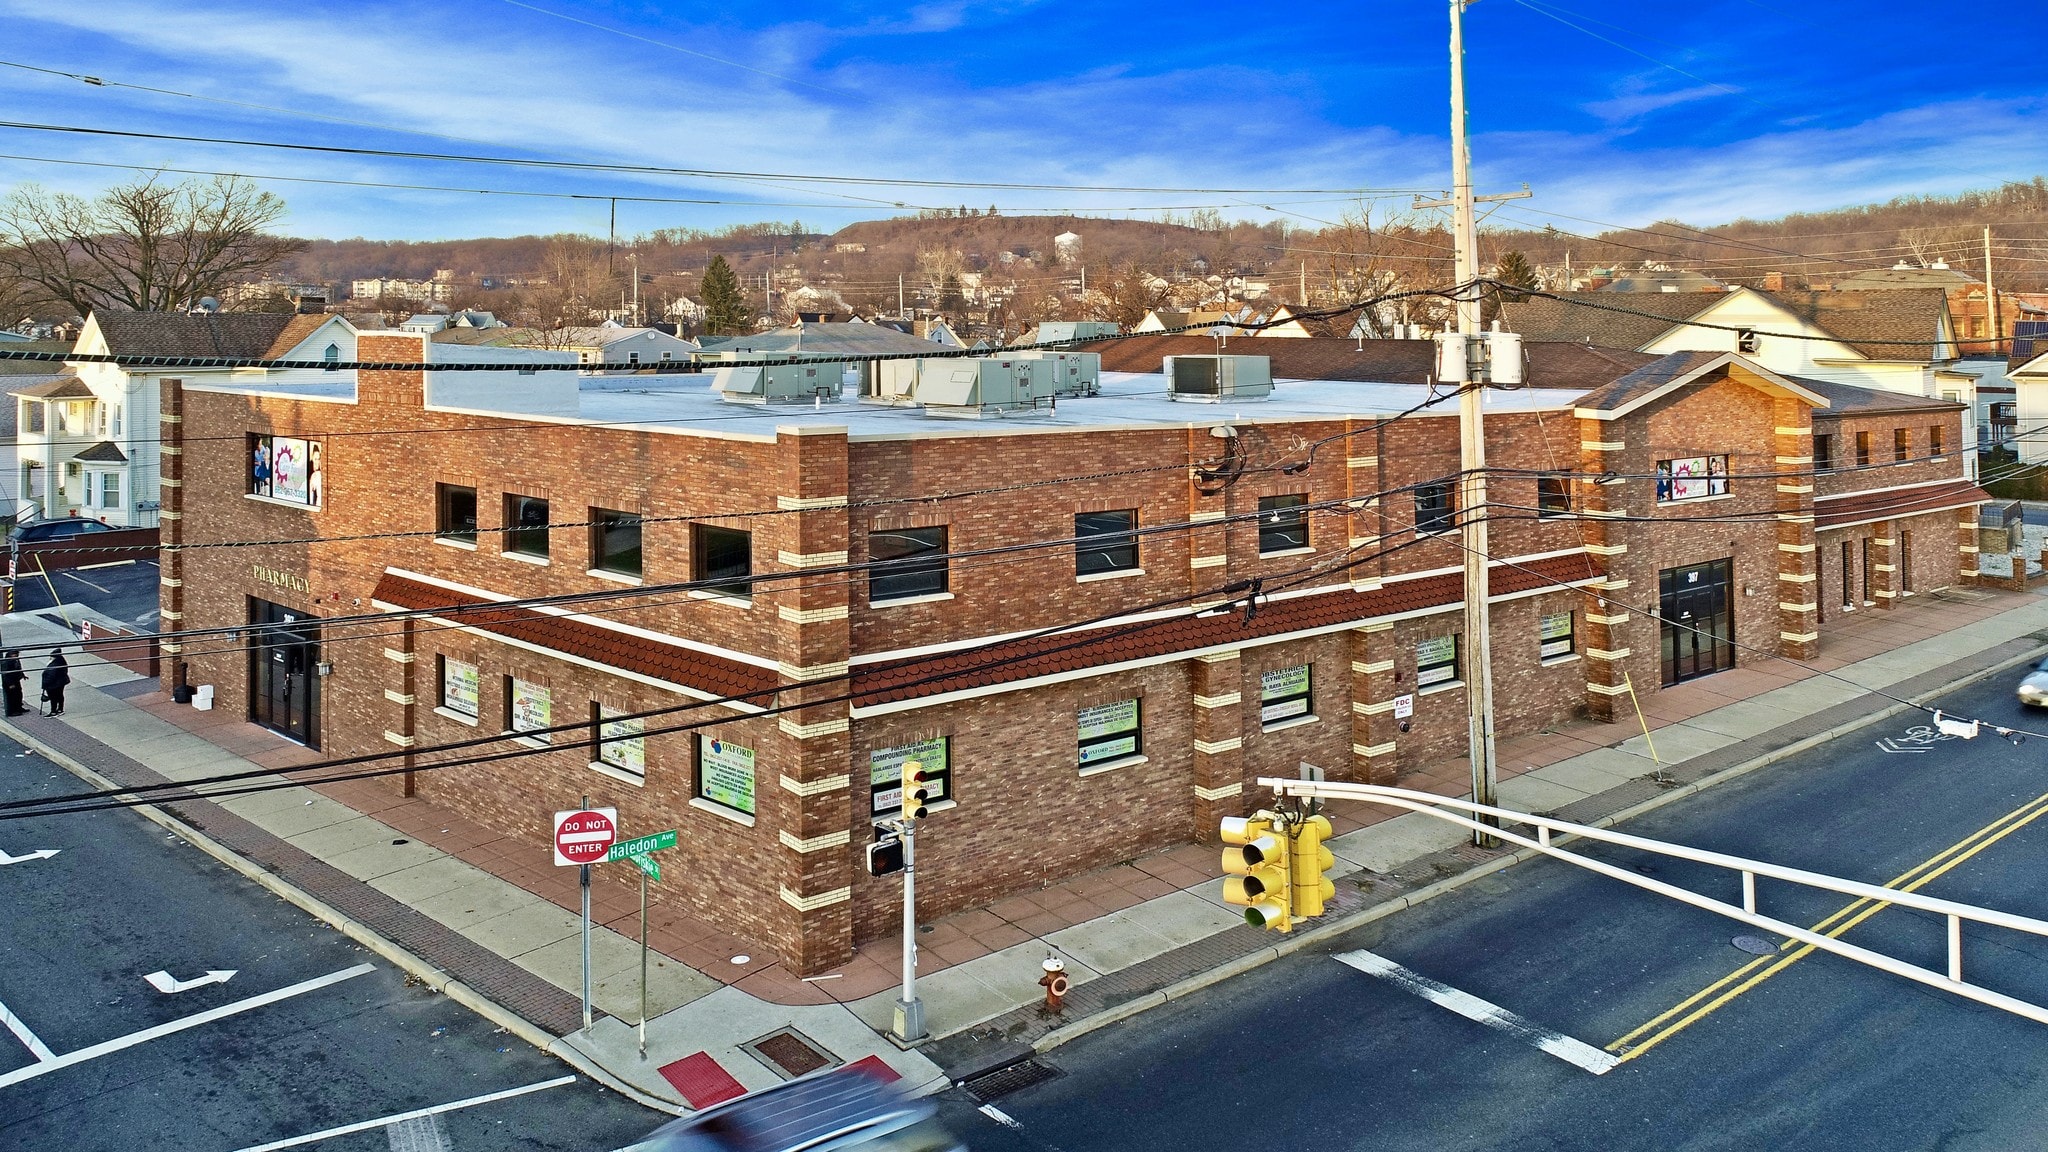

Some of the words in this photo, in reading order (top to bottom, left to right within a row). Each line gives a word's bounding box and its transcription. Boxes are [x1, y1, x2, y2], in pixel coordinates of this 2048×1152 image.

[254, 566, 310, 593] PHARMACY
[1266, 671, 1304, 682] GYNECOLOGY
[722, 742, 752, 758] OXFORD
[873, 750, 912, 762] COMPOUNDING
[913, 743, 942, 755] PHARMACY
[891, 744, 906, 752] FIRST
[877, 793, 892, 802] FIRST
[565, 823, 579, 831] DO
[586, 820, 606, 829] NOT
[569, 844, 602, 854] ENTER
[610, 838, 657, 859] Haledon
[662, 833, 674, 842] Ave
